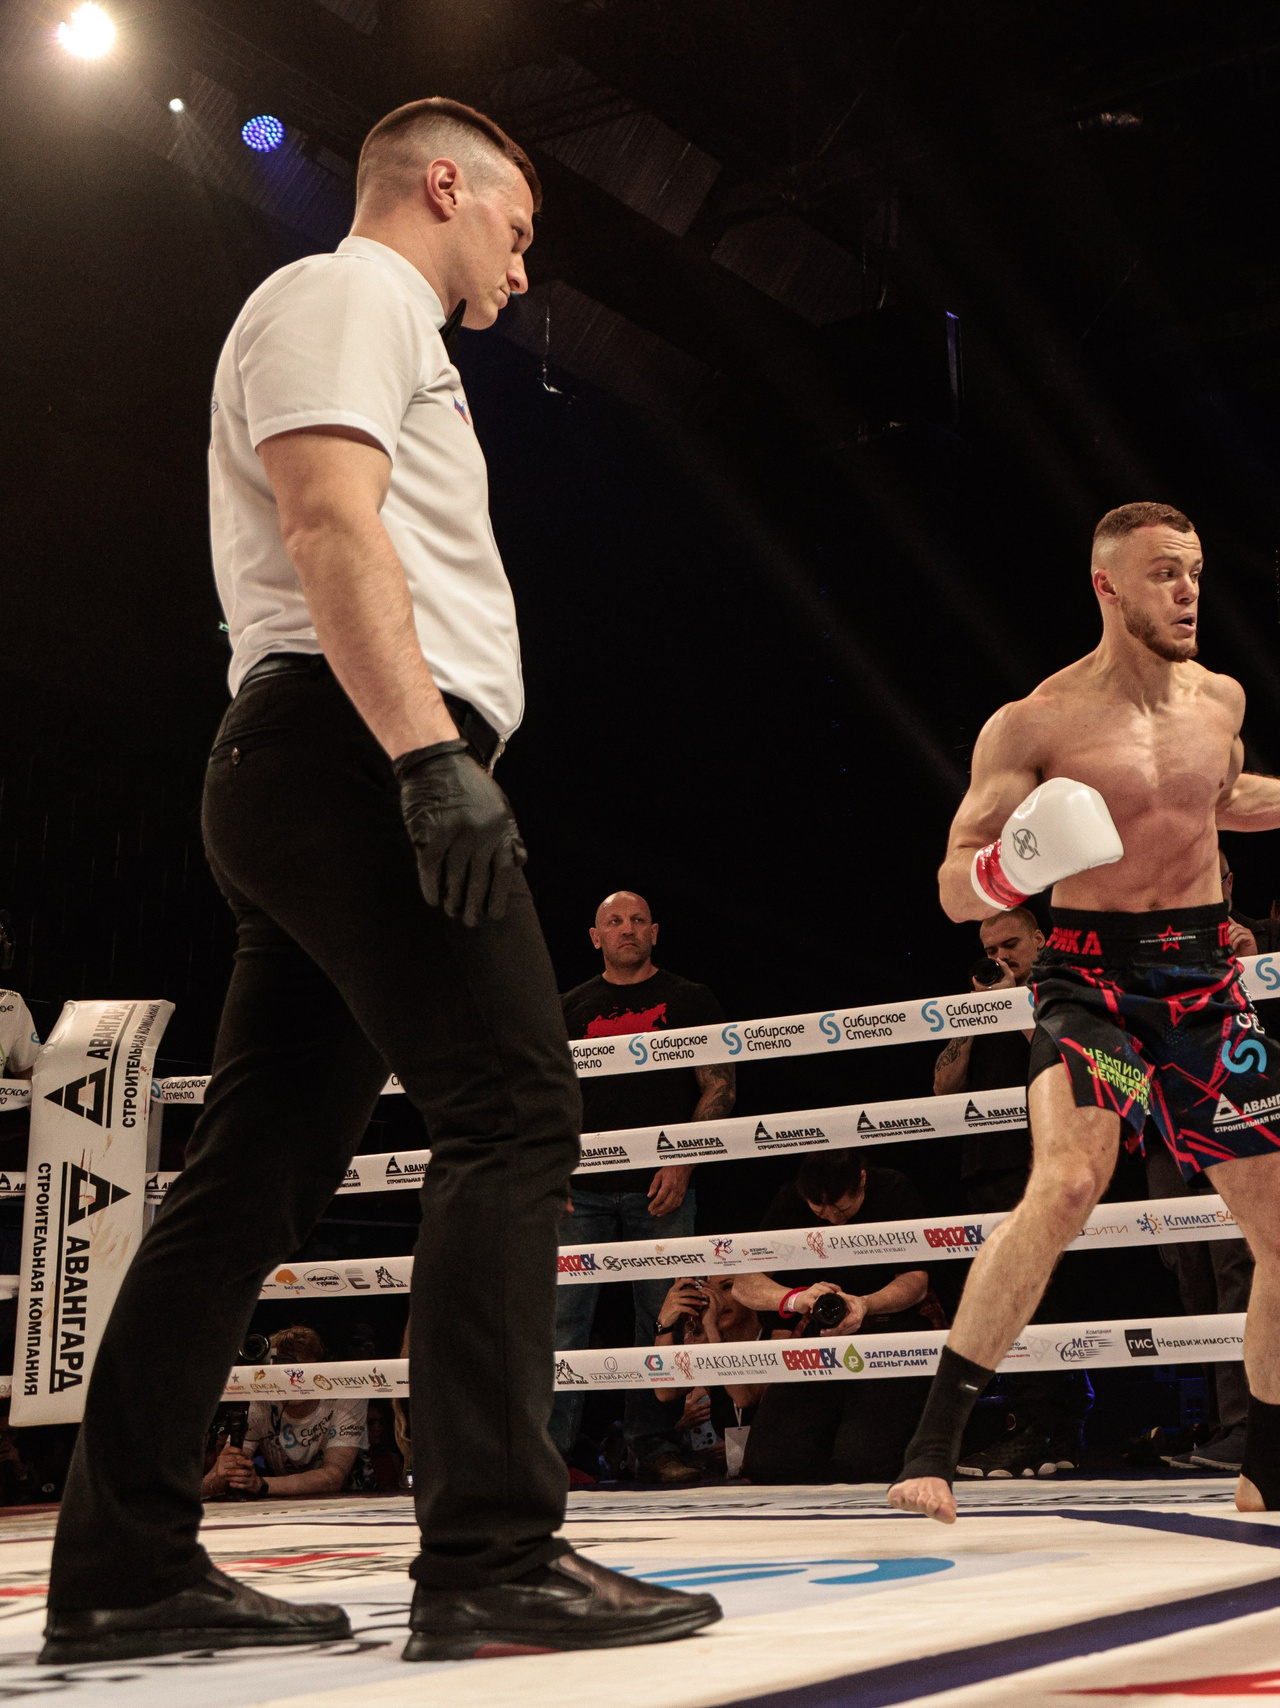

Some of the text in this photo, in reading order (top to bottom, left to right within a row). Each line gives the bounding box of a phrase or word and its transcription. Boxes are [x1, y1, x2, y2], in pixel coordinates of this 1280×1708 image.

[946, 999, 1012, 1017] Сибирское
[843, 1011, 907, 1029] Сибирское
[949, 1014, 998, 1029] Стекло
[87, 1003, 135, 1060] АВАНГАРД
[744, 1023, 805, 1040] Сибирское
[845, 1026, 893, 1041] Стекло
[650, 1034, 708, 1050] Сибирское
[746, 1037, 792, 1052] Стекло
[572, 1044, 615, 1058] бирское
[652, 1049, 695, 1062] Стекло
[122, 1033, 147, 1128] СТРОИТЕЛЬНАЯ
[162, 1090, 195, 1101] Стекло
[878, 1116, 931, 1129] АВАНГАРД
[1214, 1115, 1269, 1133] СТРОИТЕЛЬНАЯ
[775, 1127, 825, 1140] АВАНГАРД
[860, 1127, 936, 1140] СТРОИТЕЛЬНАЯ КОМПАНИЯ
[677, 1137, 725, 1149] АВАНГАРД
[757, 1138, 830, 1151] СТРОИТЕЛЬНАЯ КОМПАНИЯ
[581, 1145, 628, 1158] АВАНГАРД
[659, 1148, 728, 1161] СТРОИТЕЛЬНАЯ КОМПАНИЯ
[923, 1225, 985, 1248] BROZEK
[1078, 1225, 1129, 1237] СИТИ
[829, 1231, 918, 1250] РАКОВАРНЯ
[621, 1253, 708, 1268] FIGHTEXPERT
[24, 1163, 51, 1396] СТРОИТЕЛЬНАЯ КОМПАНИЯ
[53, 1236, 90, 1392] АВАНГАРД
[1128, 1336, 1244, 1350] ГИС Недвижимость
[782, 1347, 843, 1371] BROZEK
[864, 1348, 938, 1359] ЗАПРАВЛЯЕМ
[695, 1353, 779, 1370] РАКОВАРНЯ
[869, 1359, 928, 1369] ДЕНЬГАМИ
